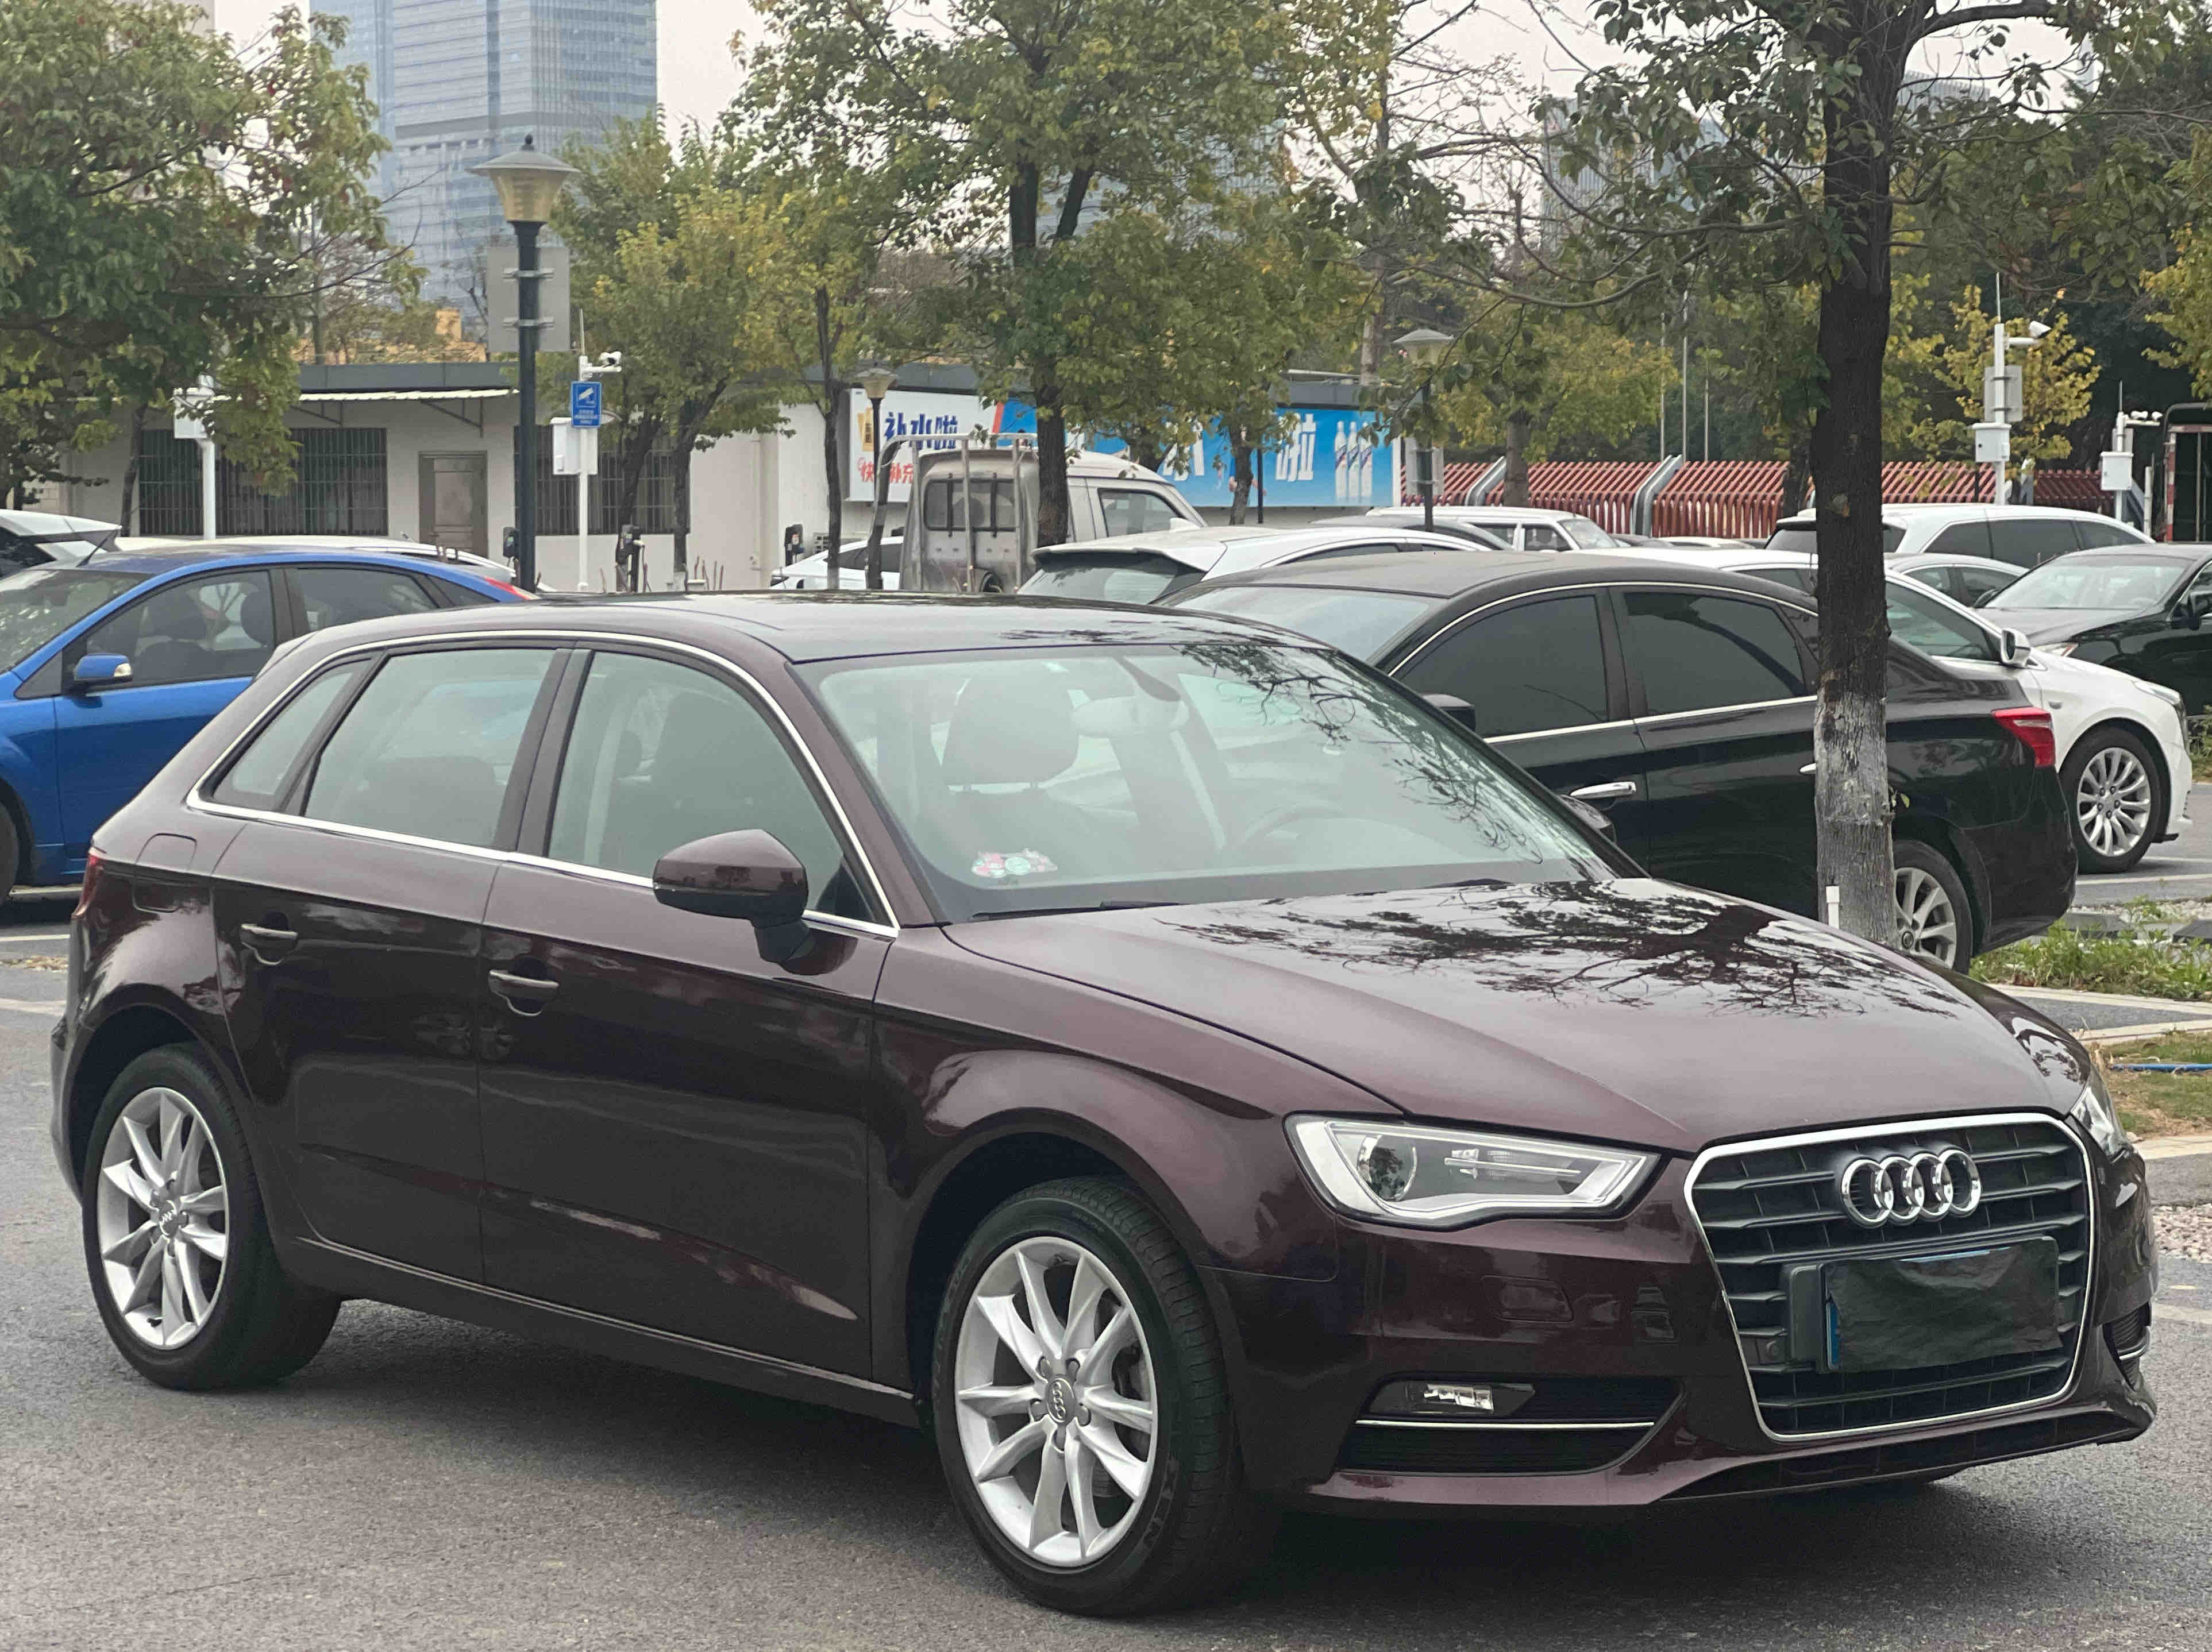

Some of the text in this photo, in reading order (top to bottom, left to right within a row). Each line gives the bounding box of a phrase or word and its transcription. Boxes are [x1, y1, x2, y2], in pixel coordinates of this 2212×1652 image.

[884, 411, 958, 450] 补水啦
[861, 460, 914, 483] 快补充
